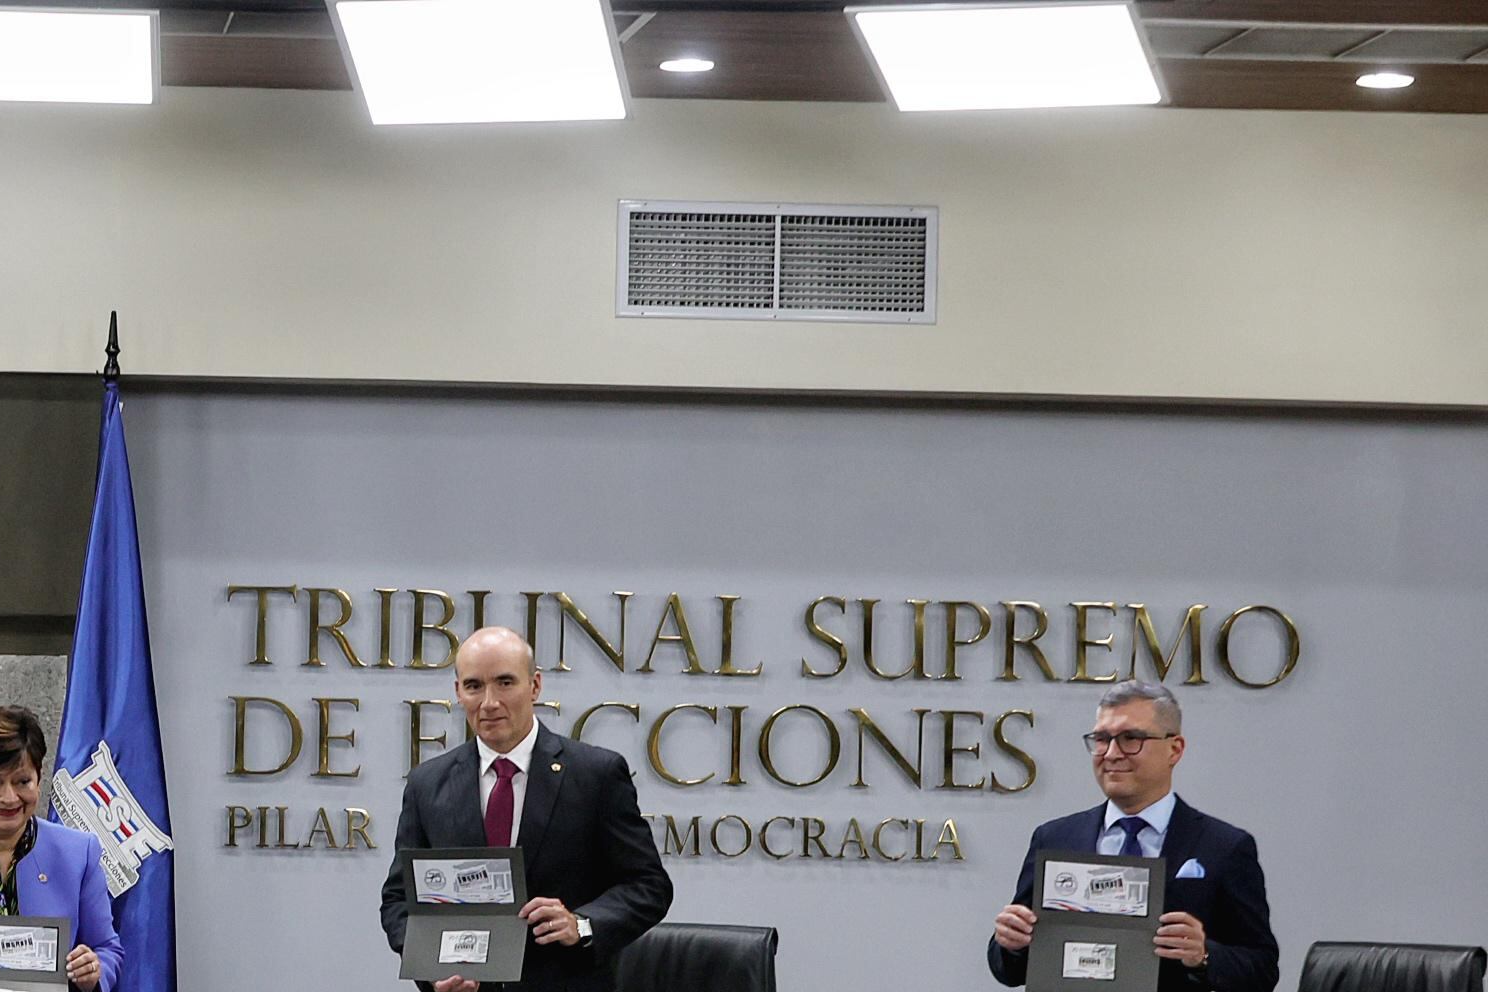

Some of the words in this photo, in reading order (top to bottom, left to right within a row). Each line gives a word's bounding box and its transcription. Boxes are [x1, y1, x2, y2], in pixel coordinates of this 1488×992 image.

[801, 596, 1300, 688] SUPREMO
[227, 696, 361, 777] DE
[224, 806, 378, 849] PILAR
[641, 814, 965, 861] MOCRACIA
